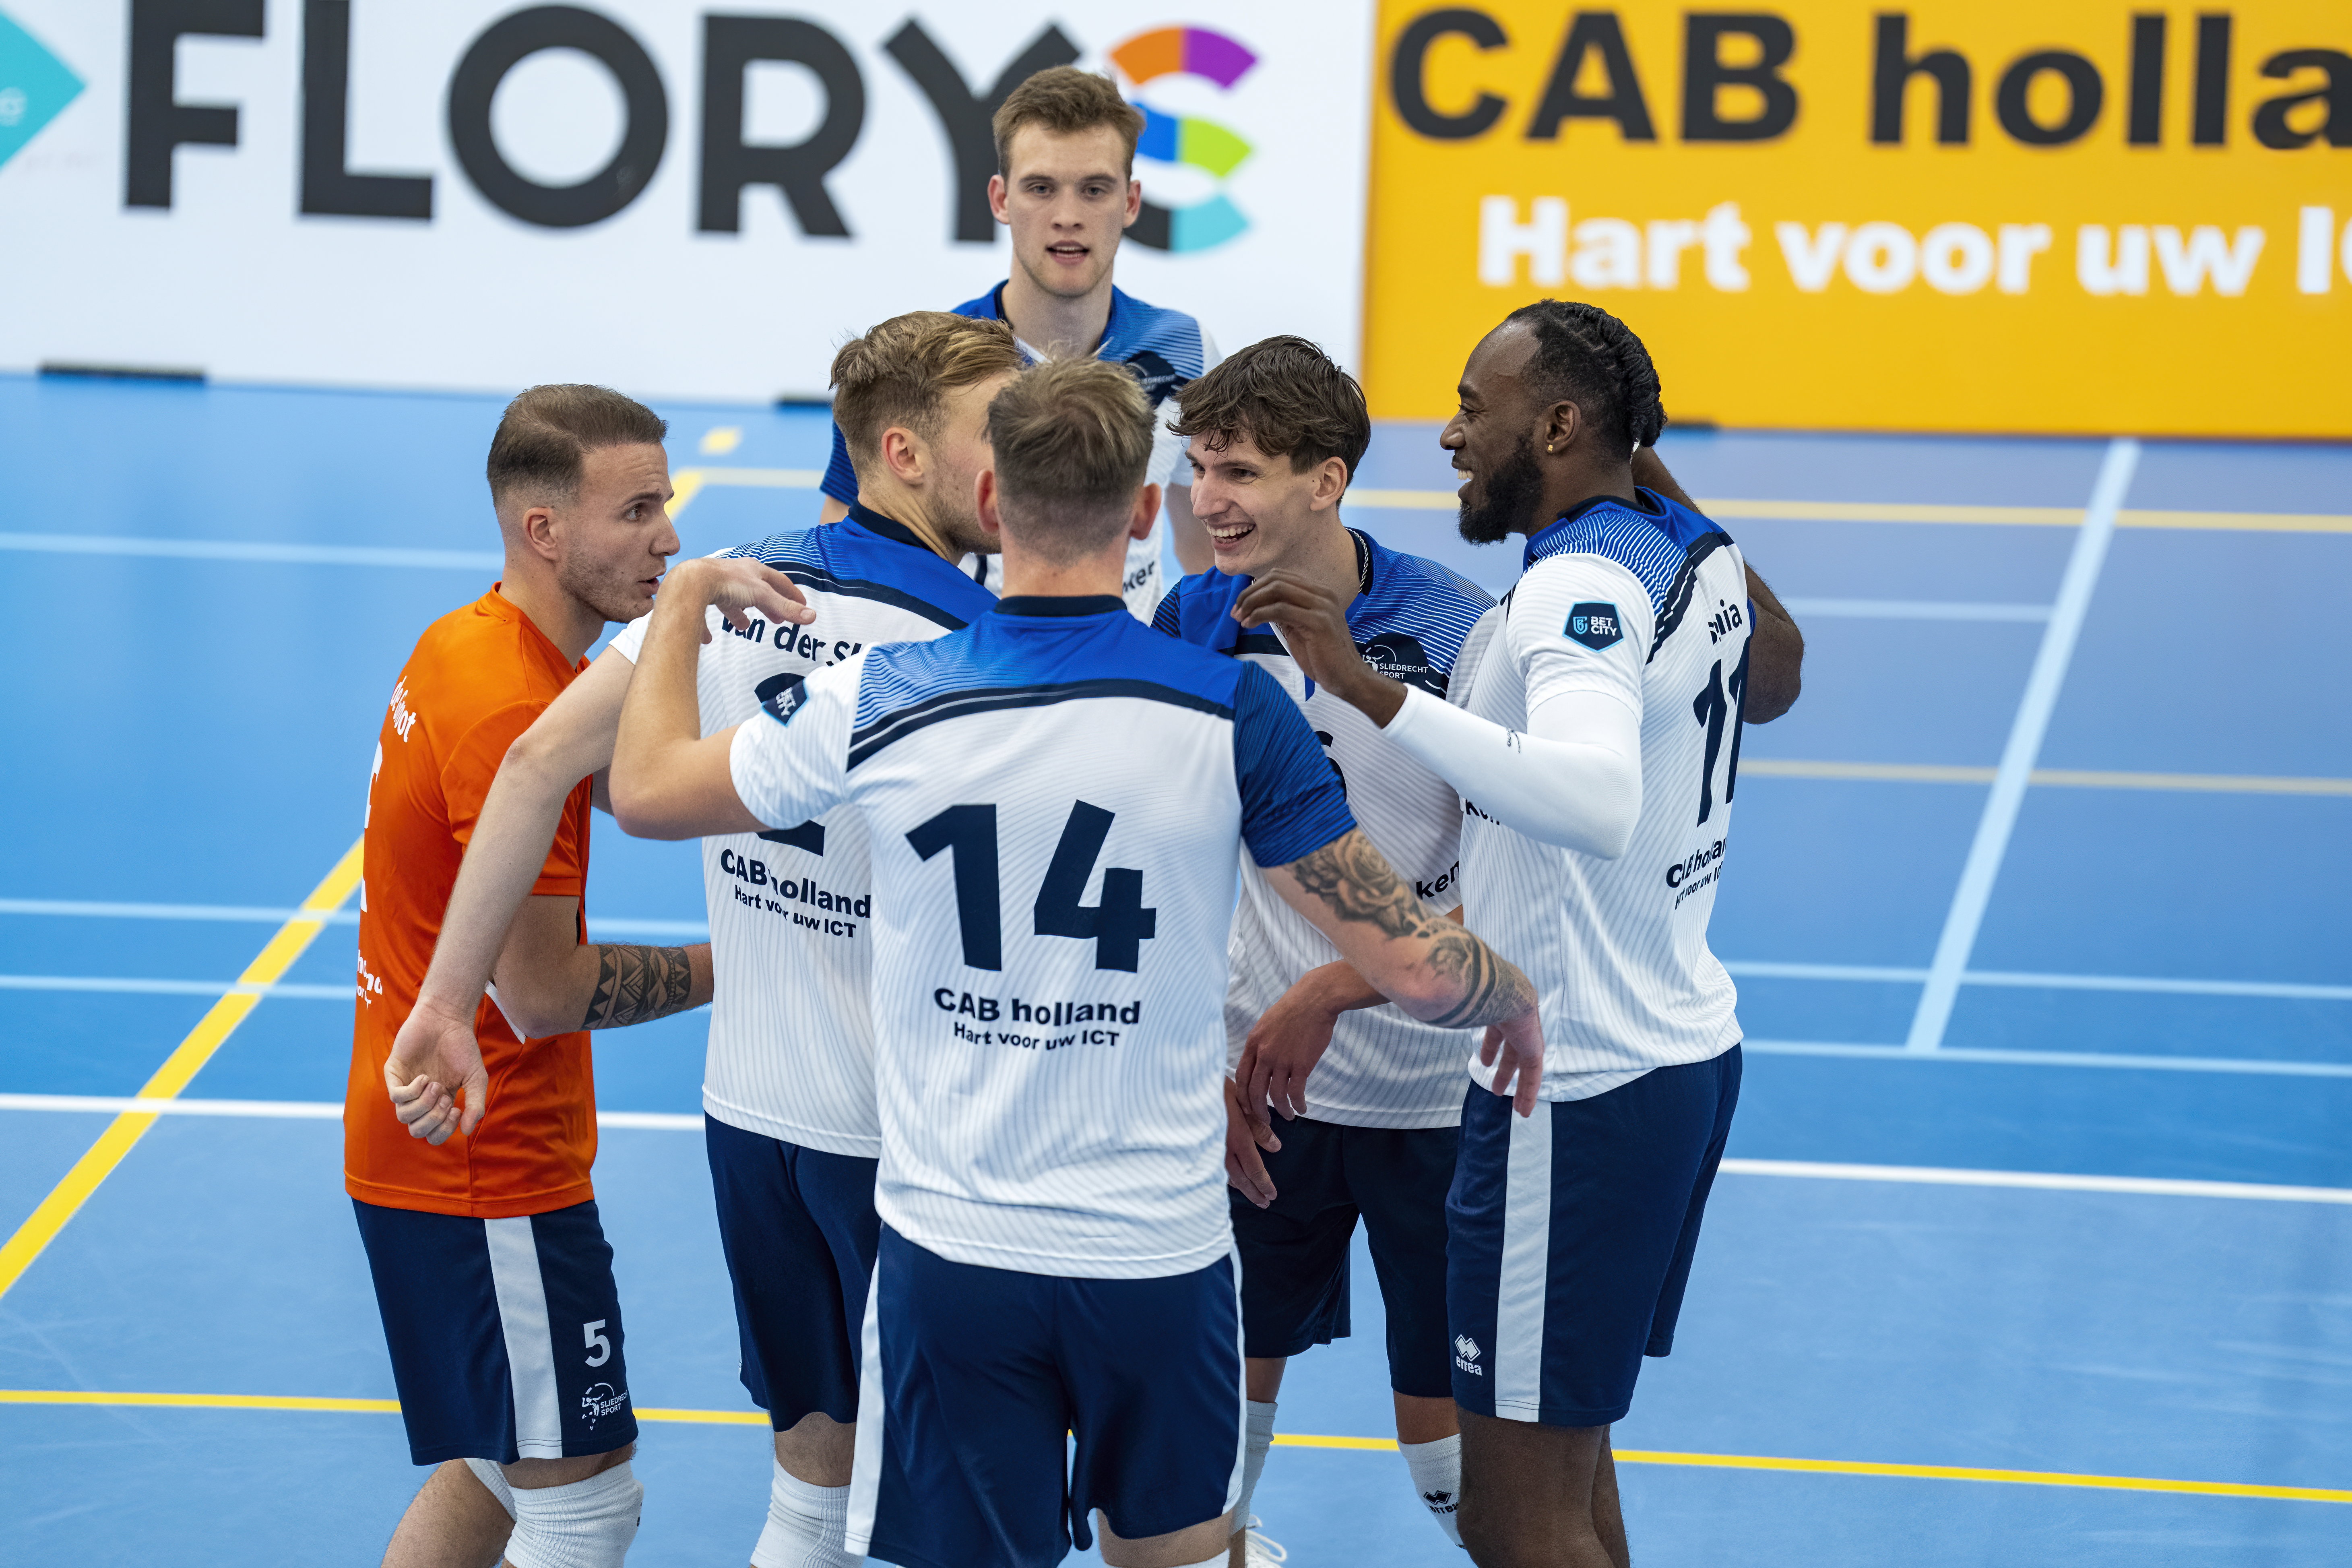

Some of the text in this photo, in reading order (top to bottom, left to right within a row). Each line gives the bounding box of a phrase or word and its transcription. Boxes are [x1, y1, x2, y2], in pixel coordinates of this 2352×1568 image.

[1390, 7, 1801, 144] CAB
[1478, 195, 2352, 297] Hart voor uw I
[1590, 616, 1613, 626] BET
[1591, 624, 1617, 636] CITY
[774, 623, 826, 662] der
[1379, 663, 1428, 673] SLIEDRECHT
[1379, 671, 1405, 679] SPORT
[721, 849, 767, 885] CAB
[904, 799, 1156, 973] 14
[735, 884, 761, 909] Hart
[793, 912, 820, 930] uw
[824, 918, 856, 938] ICT
[934, 987, 1141, 1026] CAB holland
[954, 1021, 1119, 1050] Hart voor uw ICT
[583, 1319, 611, 1367] 5
[1456, 1356, 1483, 1376] errea
[601, 1403, 621, 1416] SPORT
